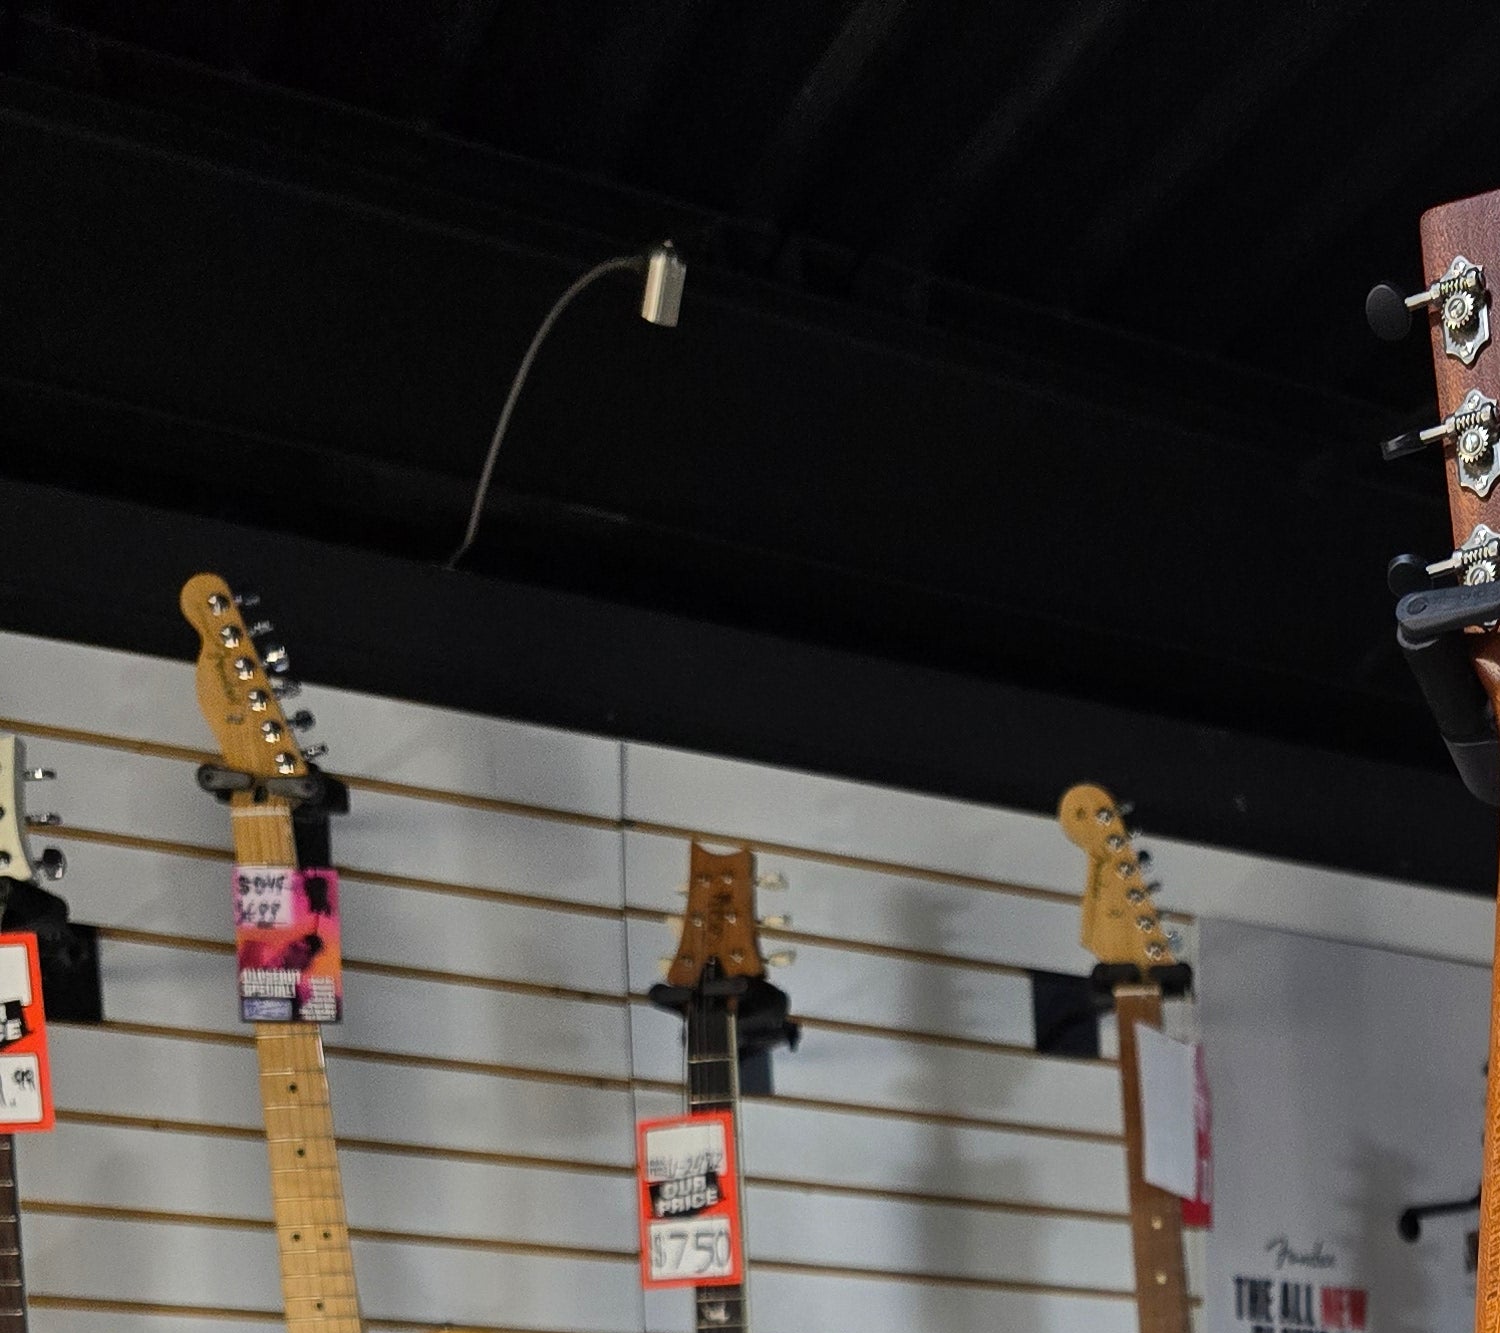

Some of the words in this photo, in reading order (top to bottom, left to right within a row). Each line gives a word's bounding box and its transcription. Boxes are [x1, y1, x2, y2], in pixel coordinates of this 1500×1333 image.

[655, 1188, 719, 1218] PRICE
[660, 1176, 707, 1200] OUR
[653, 1229, 732, 1274] $750
[1234, 1275, 1273, 1323] THE
